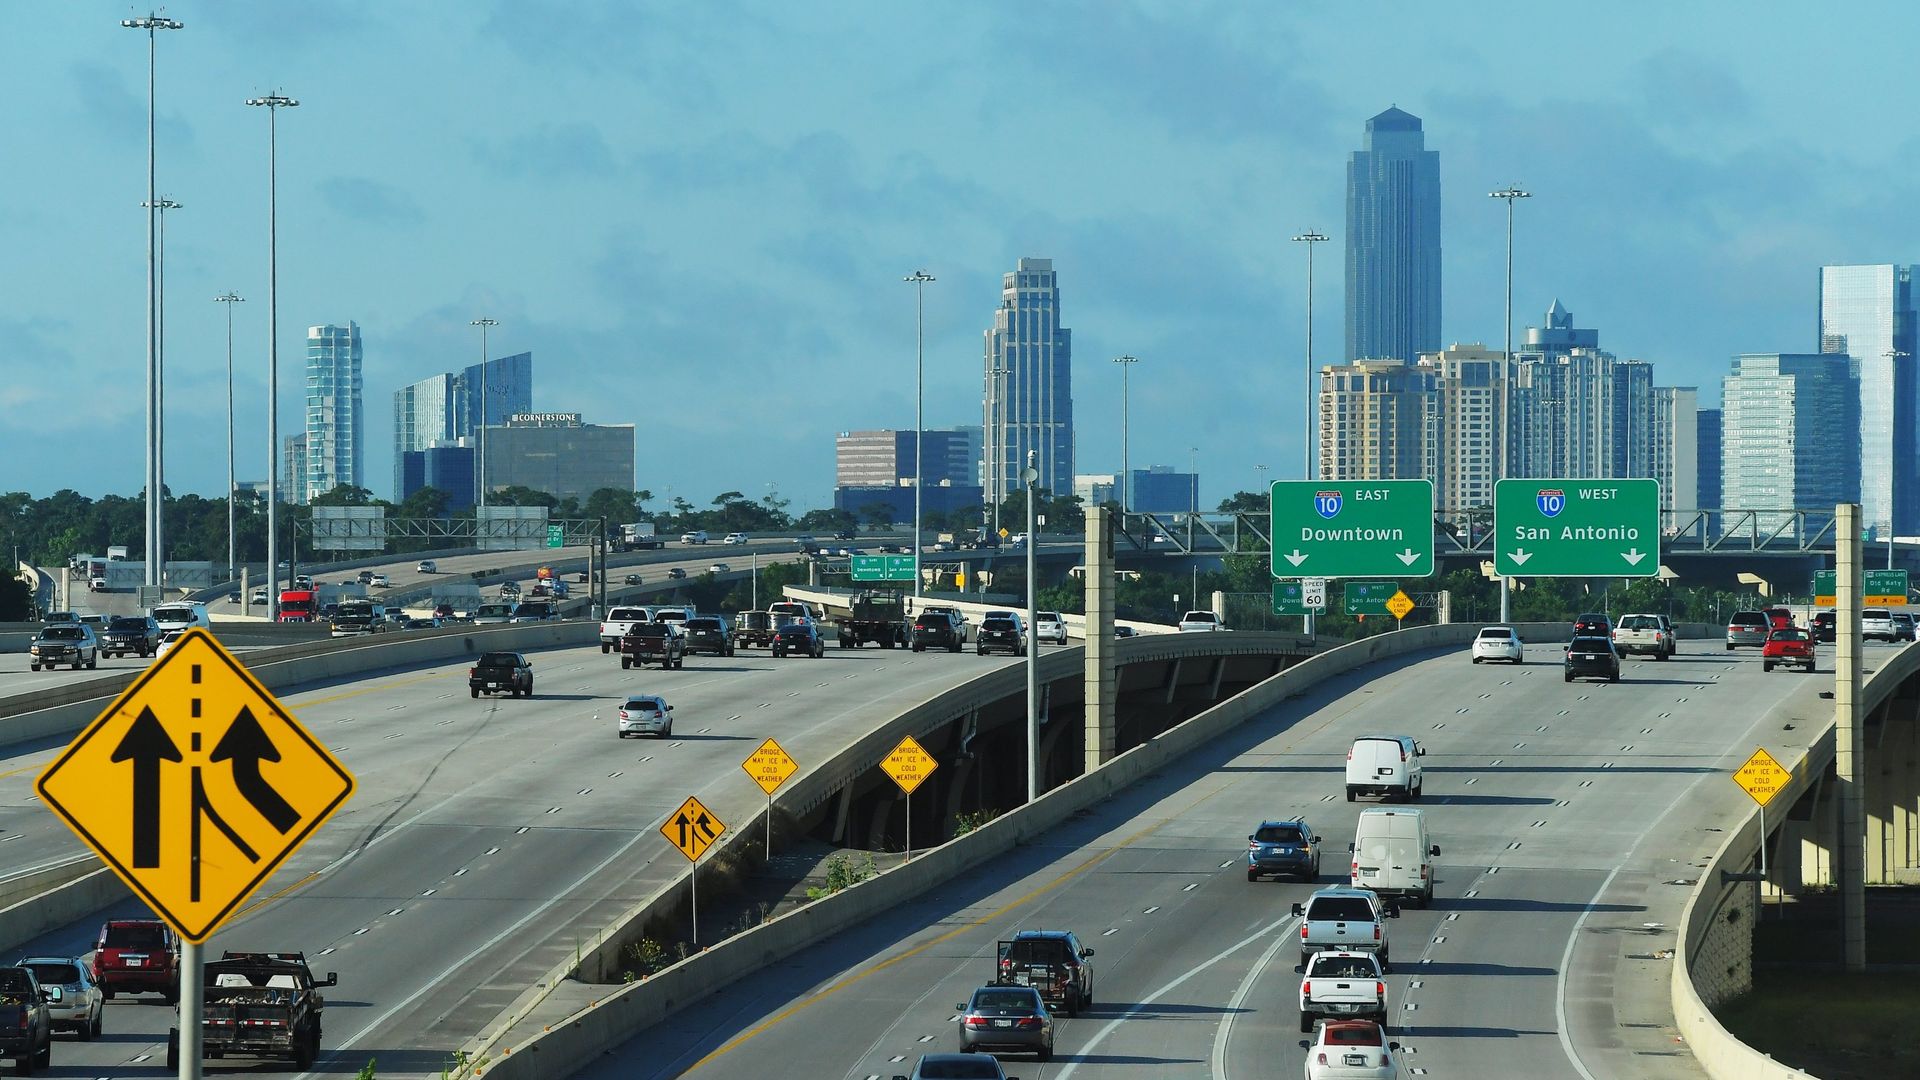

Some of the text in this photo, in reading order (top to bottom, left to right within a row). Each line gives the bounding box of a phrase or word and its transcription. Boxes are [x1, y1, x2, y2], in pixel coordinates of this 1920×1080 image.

[519, 413, 576, 422] CORNERSTONE
[1355, 490, 1390, 501] EAST
[1579, 489, 1618, 499] WEST
[1320, 498, 1337, 513] 10
[1542, 496, 1560, 512] 10
[1301, 527, 1404, 541] Downtown
[1515, 525, 1639, 540] San Antonio
[1306, 595, 1321, 604] 60
